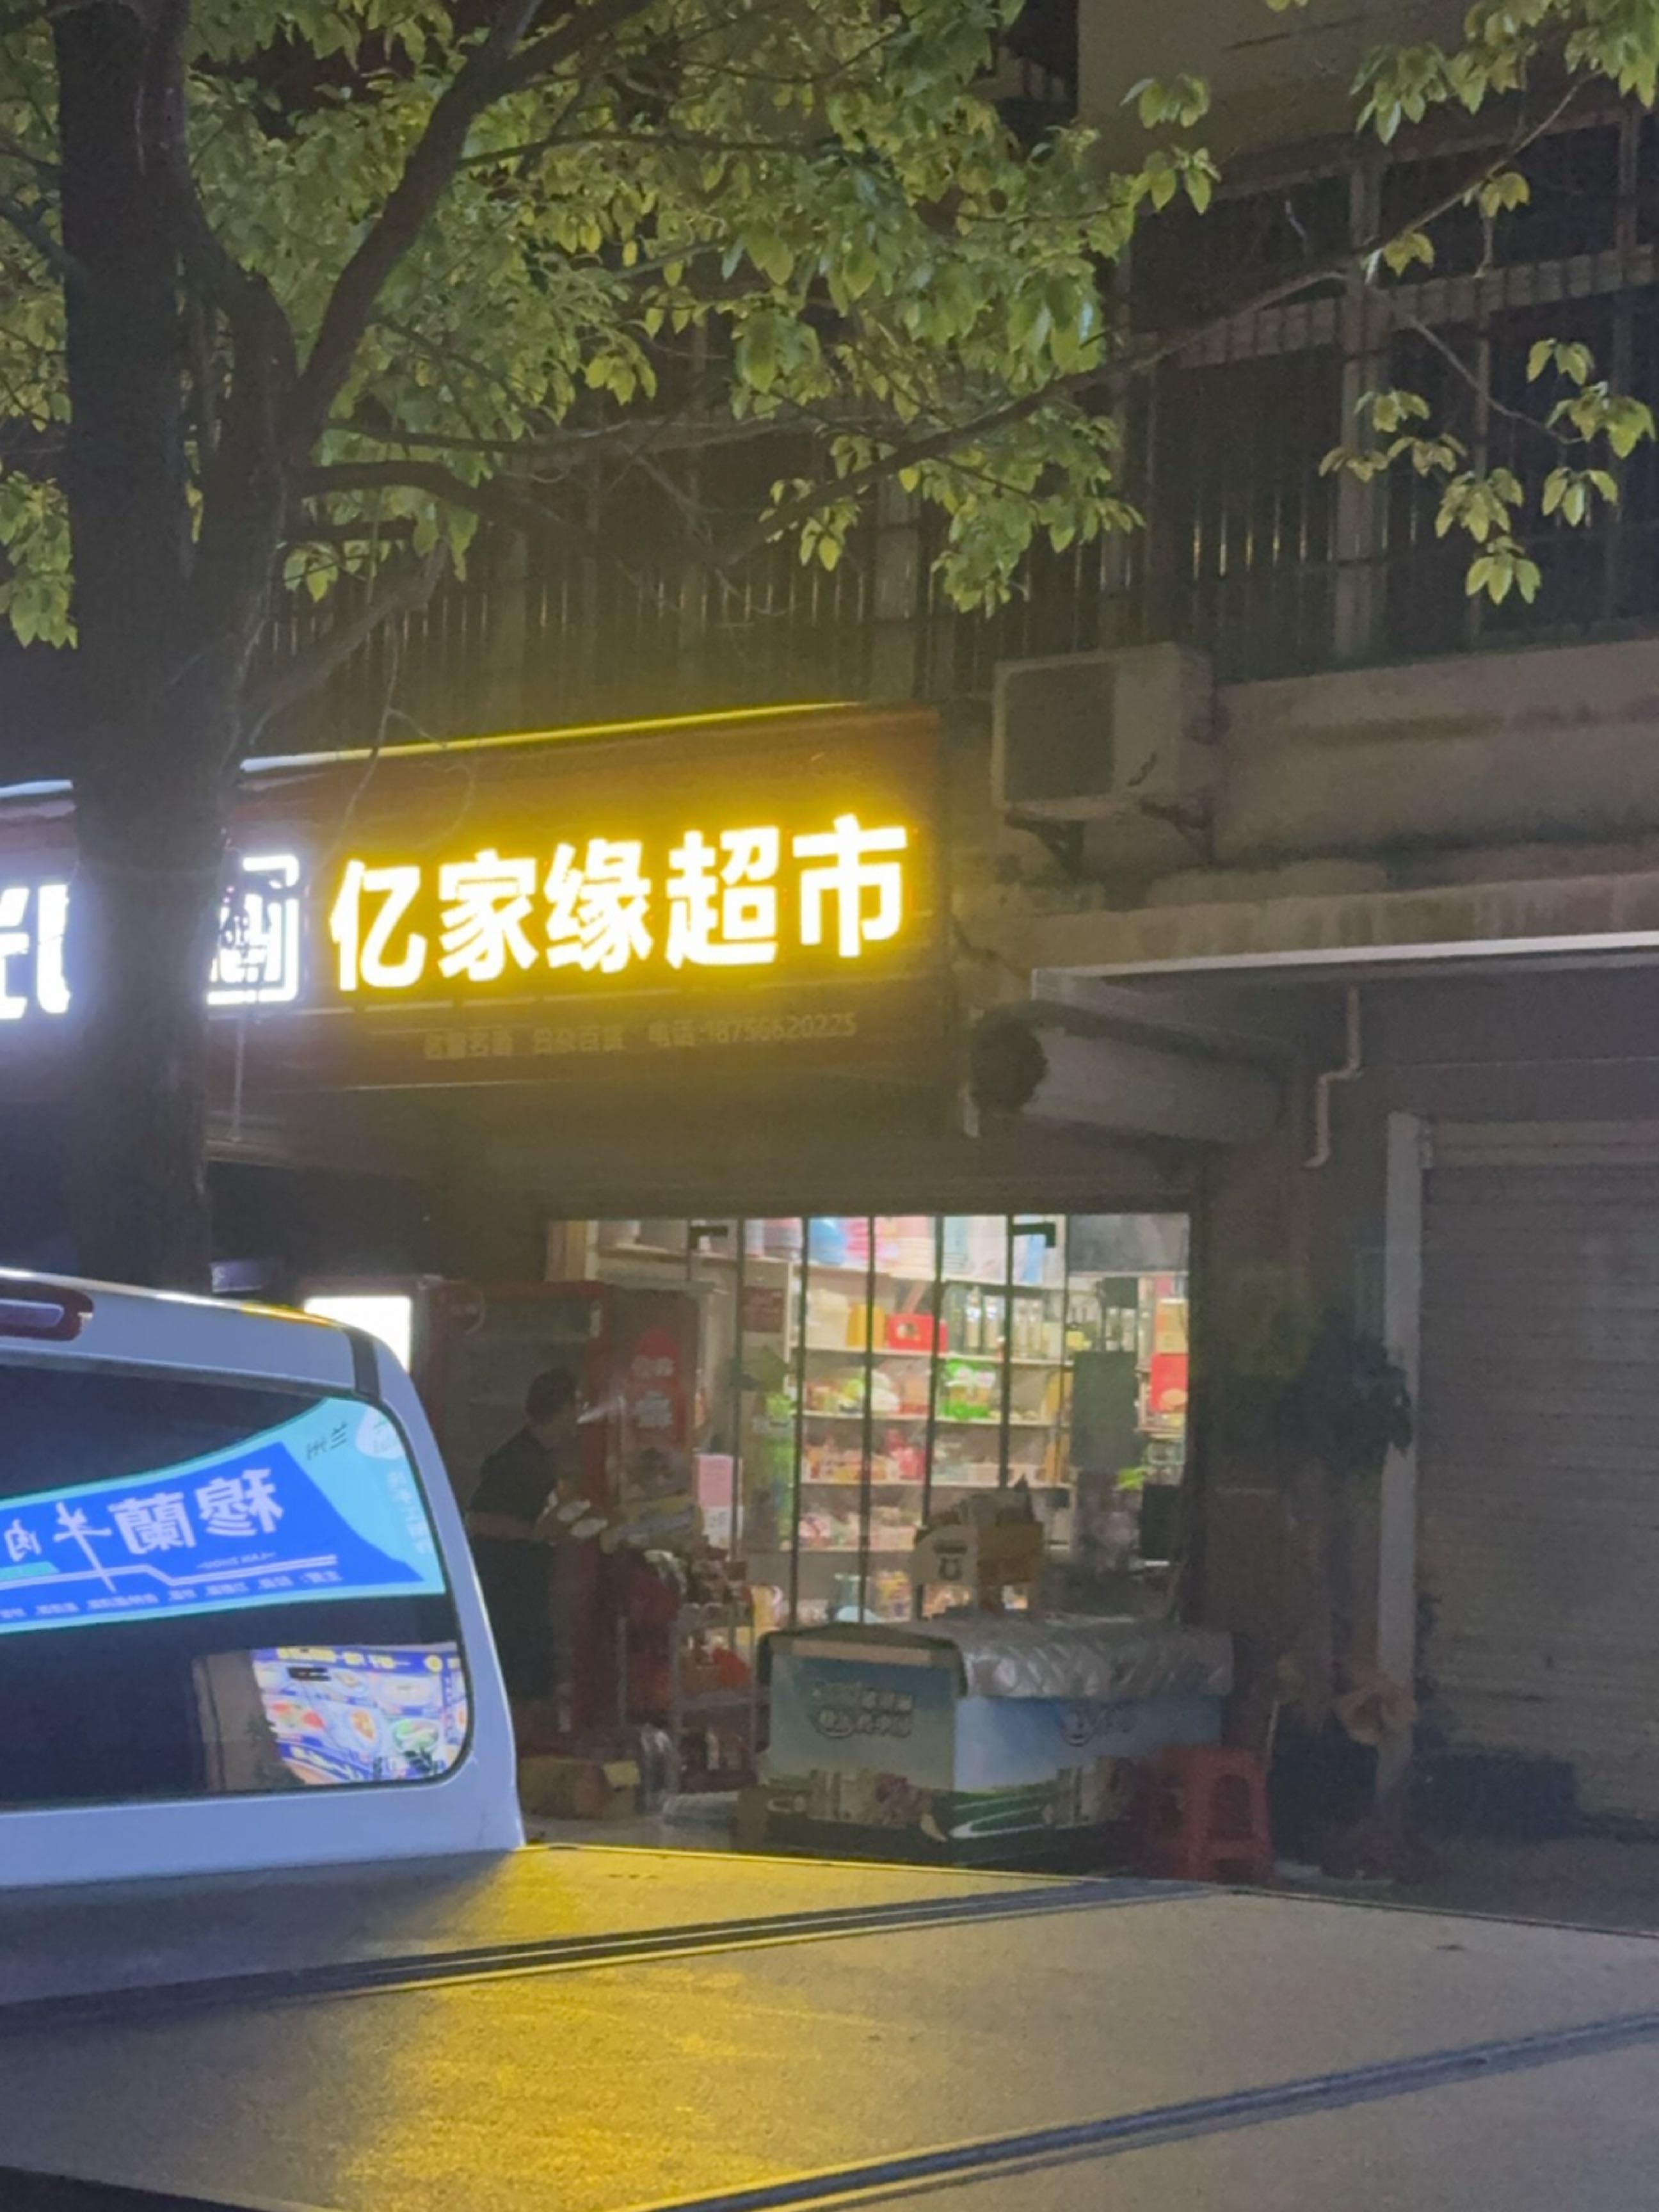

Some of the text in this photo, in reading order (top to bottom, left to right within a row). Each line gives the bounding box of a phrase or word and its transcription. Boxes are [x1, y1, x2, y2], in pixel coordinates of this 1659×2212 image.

[329, 814, 908, 991] 亿家缘超市
